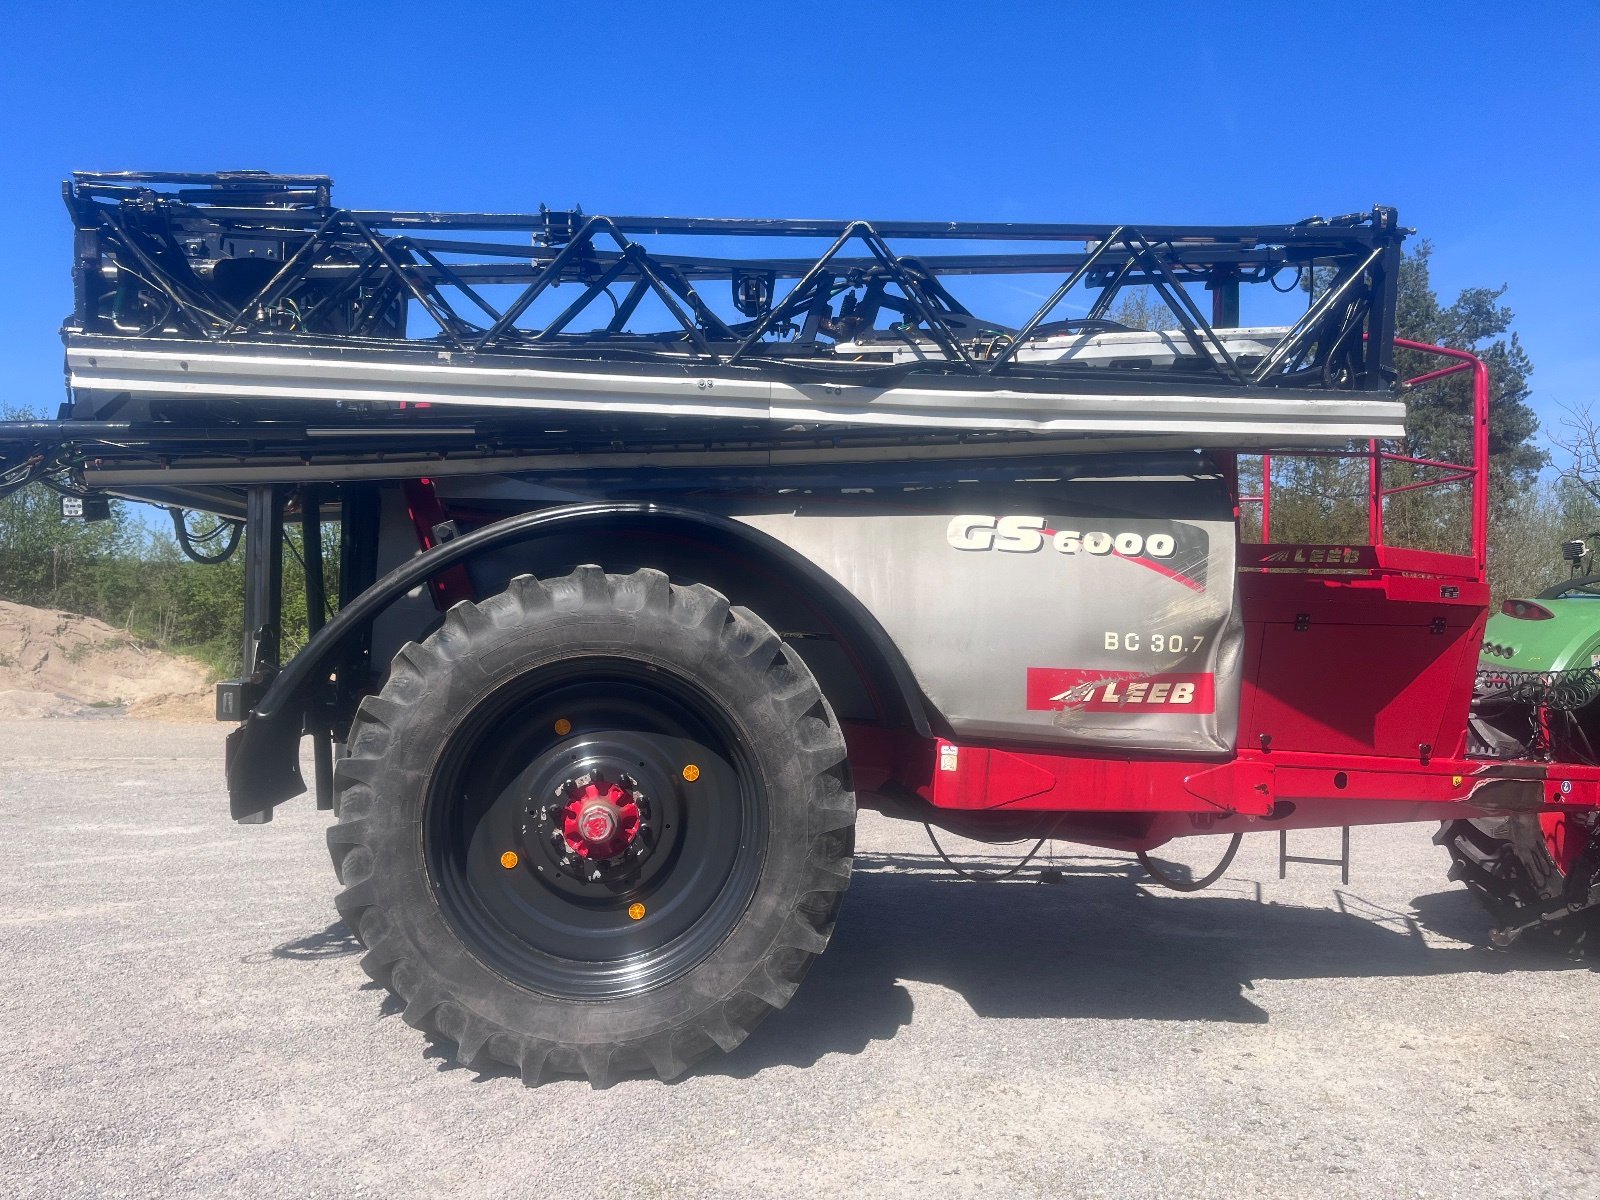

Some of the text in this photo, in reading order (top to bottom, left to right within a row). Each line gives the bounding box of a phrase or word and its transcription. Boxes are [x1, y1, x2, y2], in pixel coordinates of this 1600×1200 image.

[947, 515, 1177, 559] GS 6000
[1294, 548, 1360, 563] LEEB
[1104, 632, 1205, 653] BC 30.7
[1101, 682, 1195, 704] LEEB
